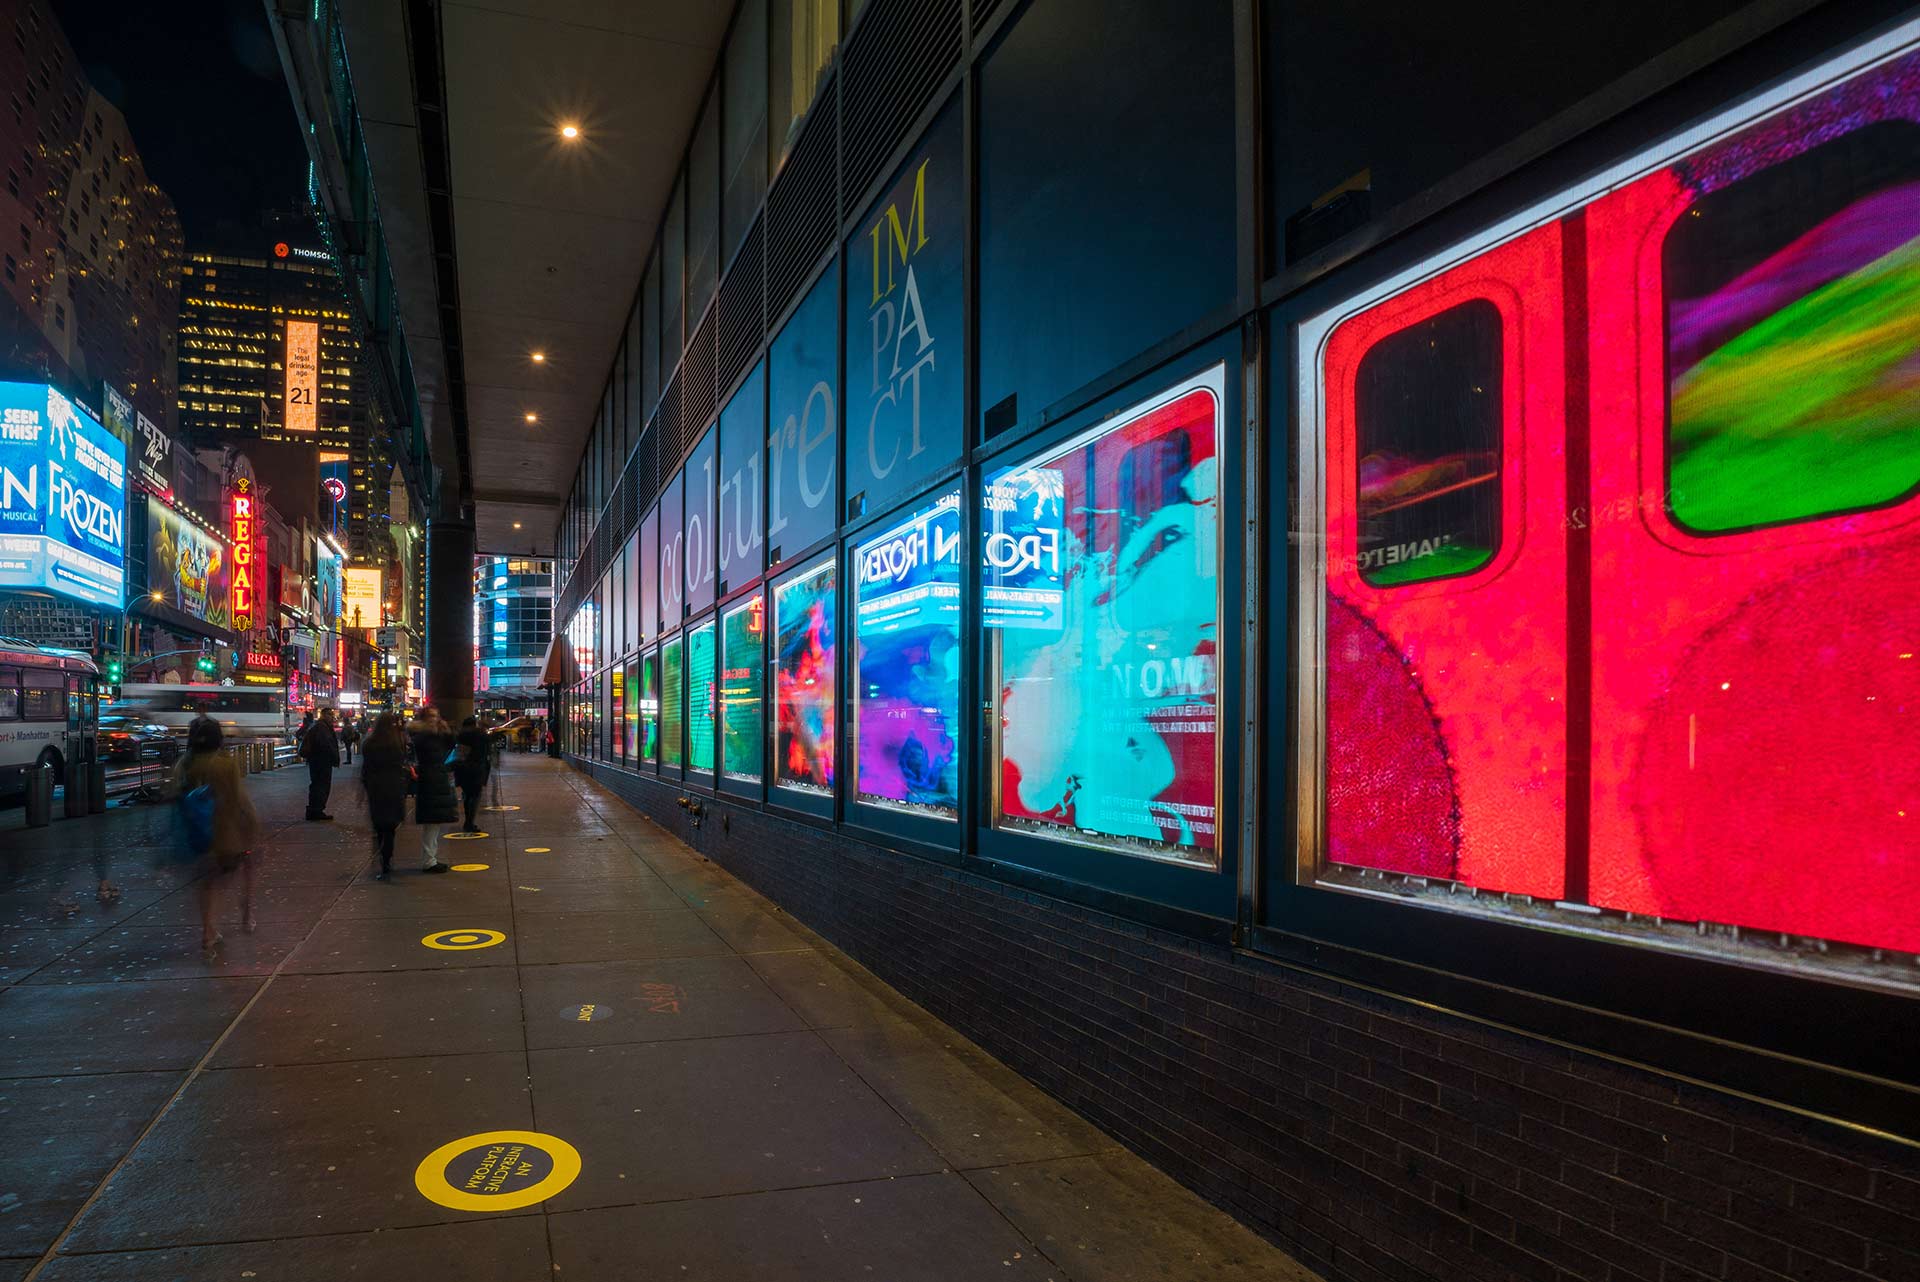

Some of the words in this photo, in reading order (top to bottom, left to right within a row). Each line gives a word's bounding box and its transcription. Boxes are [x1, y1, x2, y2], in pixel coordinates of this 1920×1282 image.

[288, 361, 315, 371] drinking
[294, 354, 310, 363] legal
[296, 369, 308, 377] age
[290, 387, 313, 405] 21
[4, 408, 38, 424] SEEN
[137, 411, 171, 455] FETTY
[48, 459, 122, 547] FROZEN
[3, 511, 38, 522] MUSICAL
[233, 497, 251, 611] REGAL
[247, 653, 281, 667] REGAL
[16, 731, 50, 741] Manhattan
[464, 1146, 505, 1190] PLATFORM
[484, 1146, 525, 1192] INTERACTIVE
[514, 1161, 534, 1177] AN
